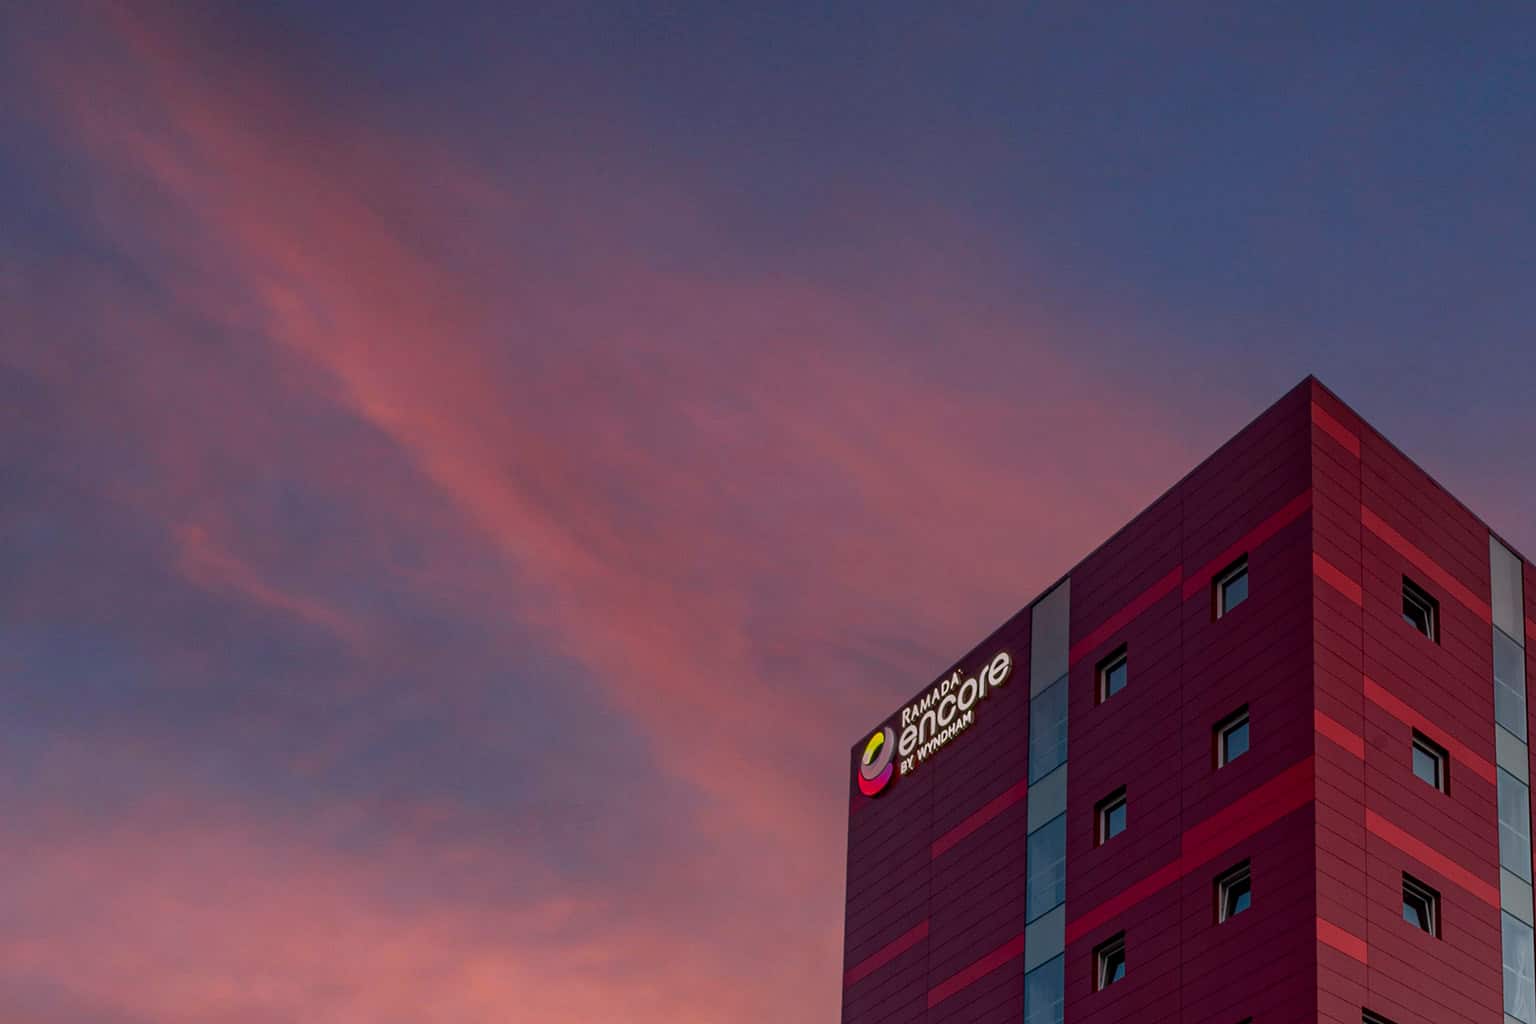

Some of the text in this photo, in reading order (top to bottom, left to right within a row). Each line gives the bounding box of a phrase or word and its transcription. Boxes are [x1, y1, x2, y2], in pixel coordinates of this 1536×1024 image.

[899, 652, 1010, 756] encore
[902, 673, 960, 727] RAMADA
[900, 710, 972, 774] BY WYNDHAM
